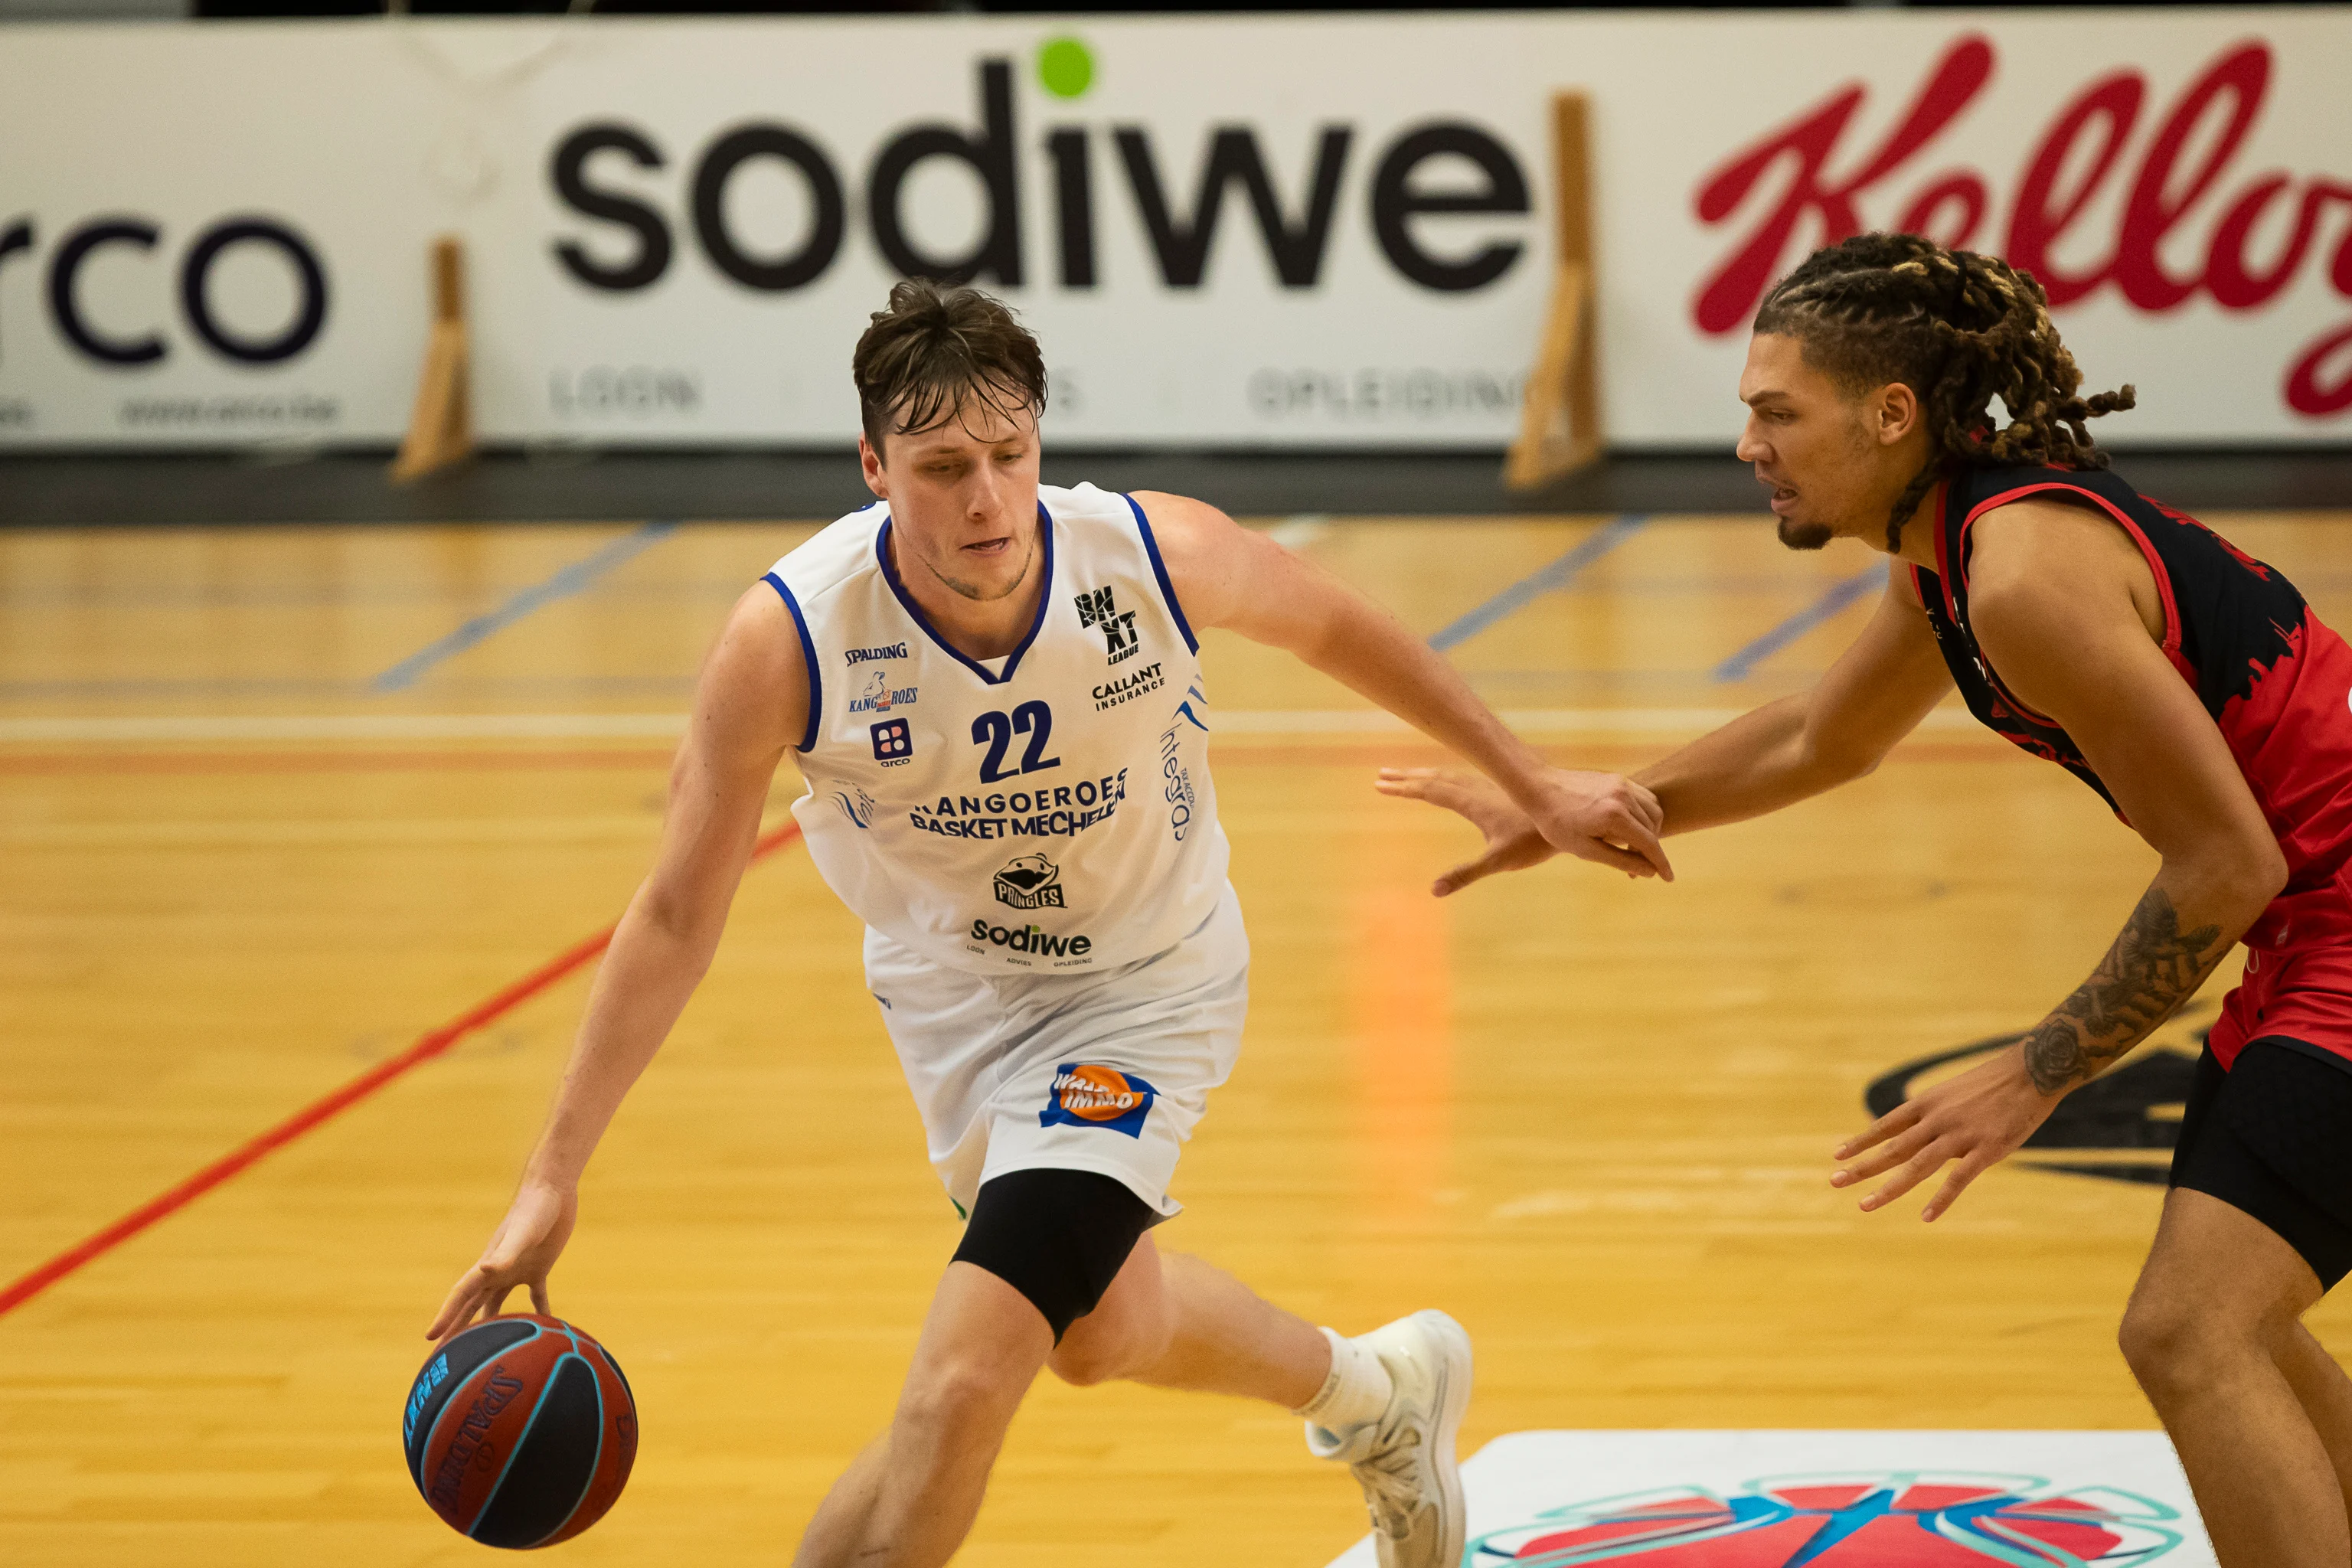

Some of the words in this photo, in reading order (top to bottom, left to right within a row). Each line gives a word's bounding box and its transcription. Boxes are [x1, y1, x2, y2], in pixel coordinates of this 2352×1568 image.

[550, 35, 1533, 297] sodiwe
[1250, 369, 1524, 420] OPLEIDIN
[844, 642, 908, 668] SPALDING
[1107, 643, 1139, 666] LEAGUE
[1092, 662, 1161, 700] CALLANT
[1096, 678, 1165, 712] INSURANCE
[970, 699, 1061, 784] 22
[880, 757, 911, 768] arco
[914, 767, 1129, 818] ANGOEROE
[910, 812, 1008, 839] BASKET
[998, 883, 1061, 908] PRINGLES
[966, 944, 986, 956] LOON
[971, 919, 1093, 957] sodiwe
[1006, 957, 1032, 967] ADVIES
[1053, 957, 1093, 968] OPLEIDING
[1064, 1091, 1134, 1109] IMMO
[430, 1364, 524, 1516] SPALDING
